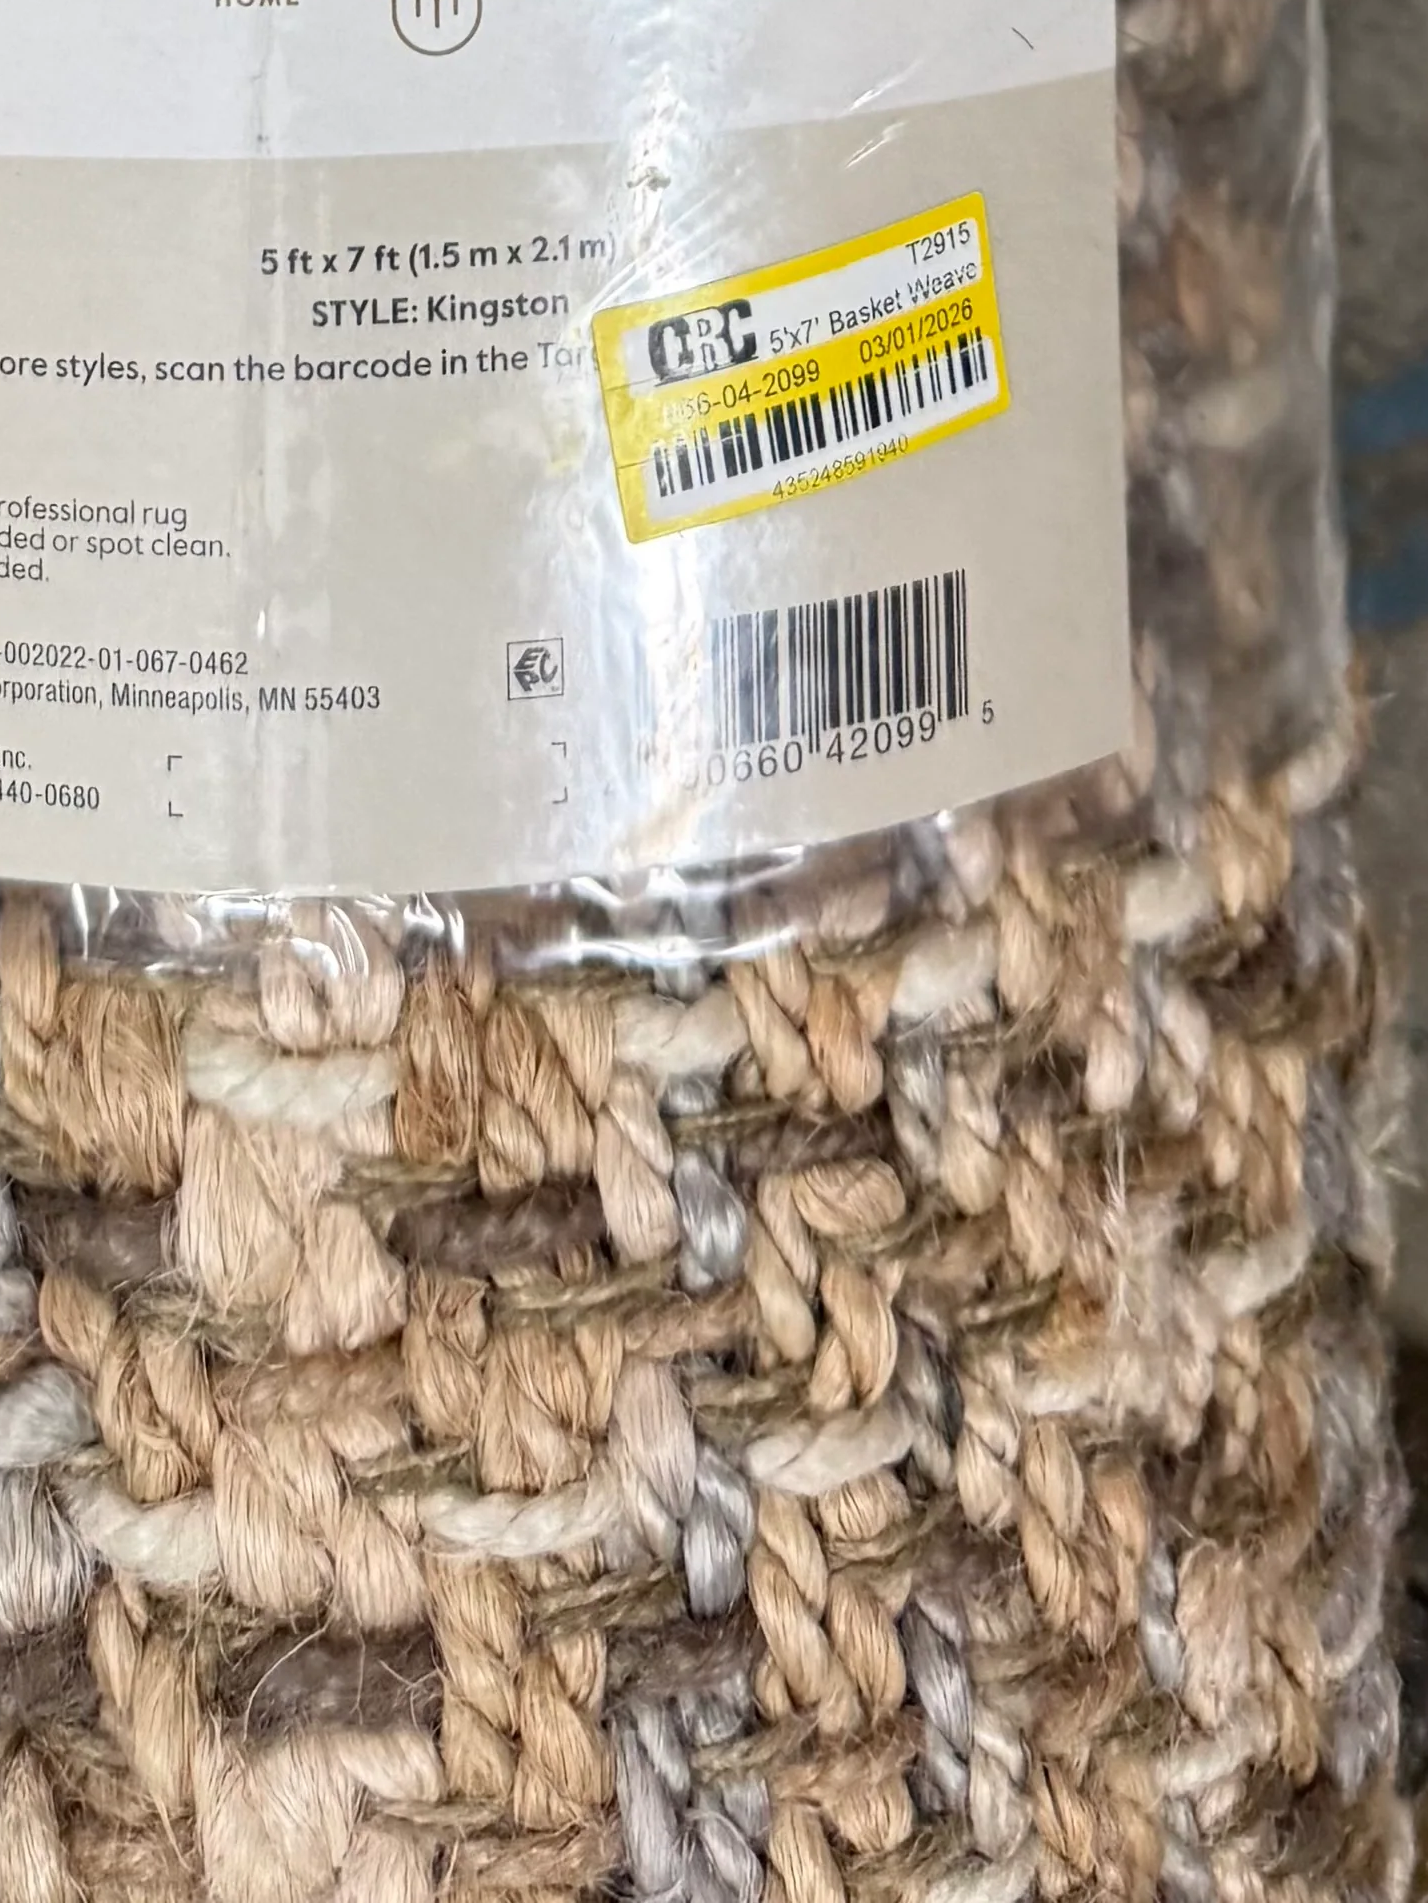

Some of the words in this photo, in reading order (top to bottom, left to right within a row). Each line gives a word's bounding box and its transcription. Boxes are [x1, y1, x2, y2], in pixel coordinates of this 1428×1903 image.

[260, 248, 279, 276] 5
[287, 246, 314, 276] ft
[321, 254, 339, 274] x
[346, 245, 366, 273] 7
[374, 244, 401, 272] ft
[408, 241, 461, 278] (1.5
[469, 246, 498, 267] m
[506, 243, 523, 265] x
[531, 234, 571, 263] 2.1
[904, 220, 972, 266] T2915
[311, 298, 419, 328] STYLE:
[427, 292, 570, 327] Kingston
[769, 316, 820, 356] 5'x7'
[828, 288, 904, 336] Basket
[906, 261, 978, 305] Weave
[55, 351, 148, 387] styles,
[154, 357, 226, 383] scan
[233, 353, 285, 382] the
[293, 349, 433, 382] barcode
[440, 348, 469, 376] in
[477, 344, 530, 373] the
[537, 341, 599, 374] Tar
[665, 358, 821, 422] 6-04-2099
[858, 296, 974, 365] 03/01/2026
[772, 432, 909, 500] 435248591940
[142, 505, 188, 533] rug
[52, 533, 80, 553] or
[86, 533, 145, 561] spot
[151, 531, 232, 558] clean.
[111, 681, 251, 716] Minneapolis,
[258, 686, 297, 713] MN
[304, 684, 381, 712] 55403
[825, 709, 936, 764] 42099
[981, 698, 996, 726] 5
